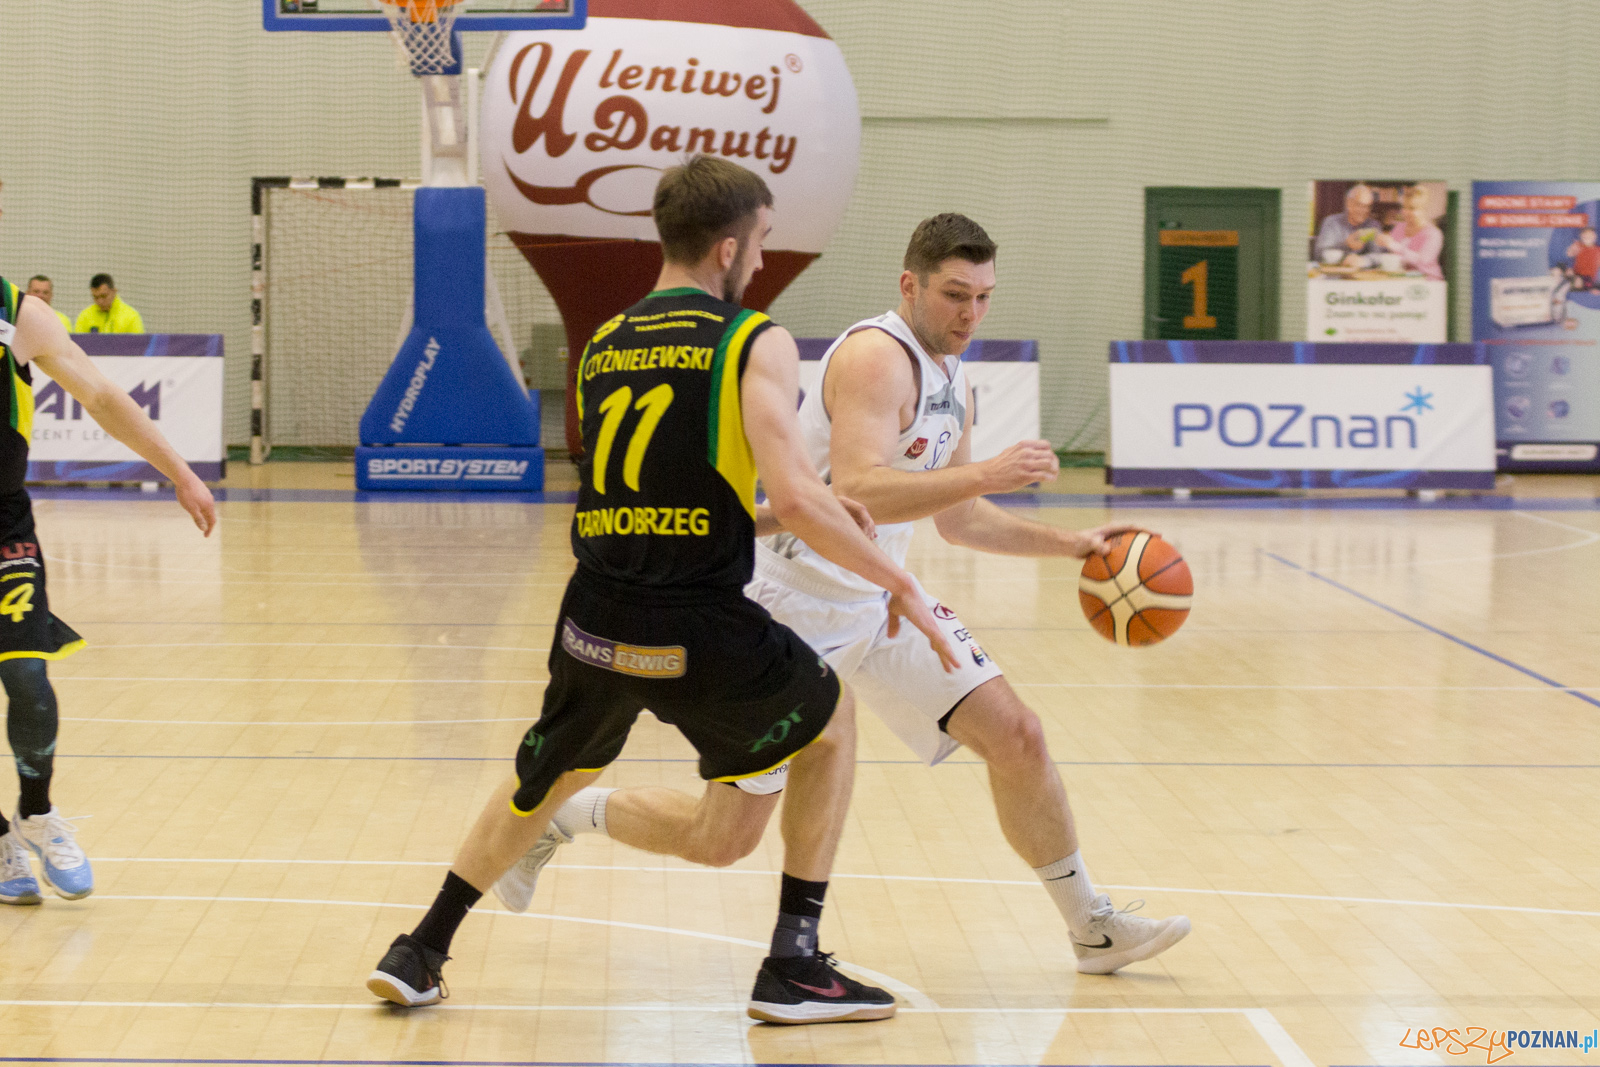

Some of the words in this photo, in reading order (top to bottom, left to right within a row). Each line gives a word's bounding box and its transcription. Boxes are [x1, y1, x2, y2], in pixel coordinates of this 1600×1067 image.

[509, 42, 592, 158] U
[599, 48, 781, 114] leniwej
[584, 95, 797, 174] Danuty
[1182, 260, 1217, 328] 1
[390, 337, 440, 433] HYDROPLAY
[593, 383, 675, 495] 11
[576, 507, 710, 538] TARNOBRZEG
[0, 583, 35, 623] 4
